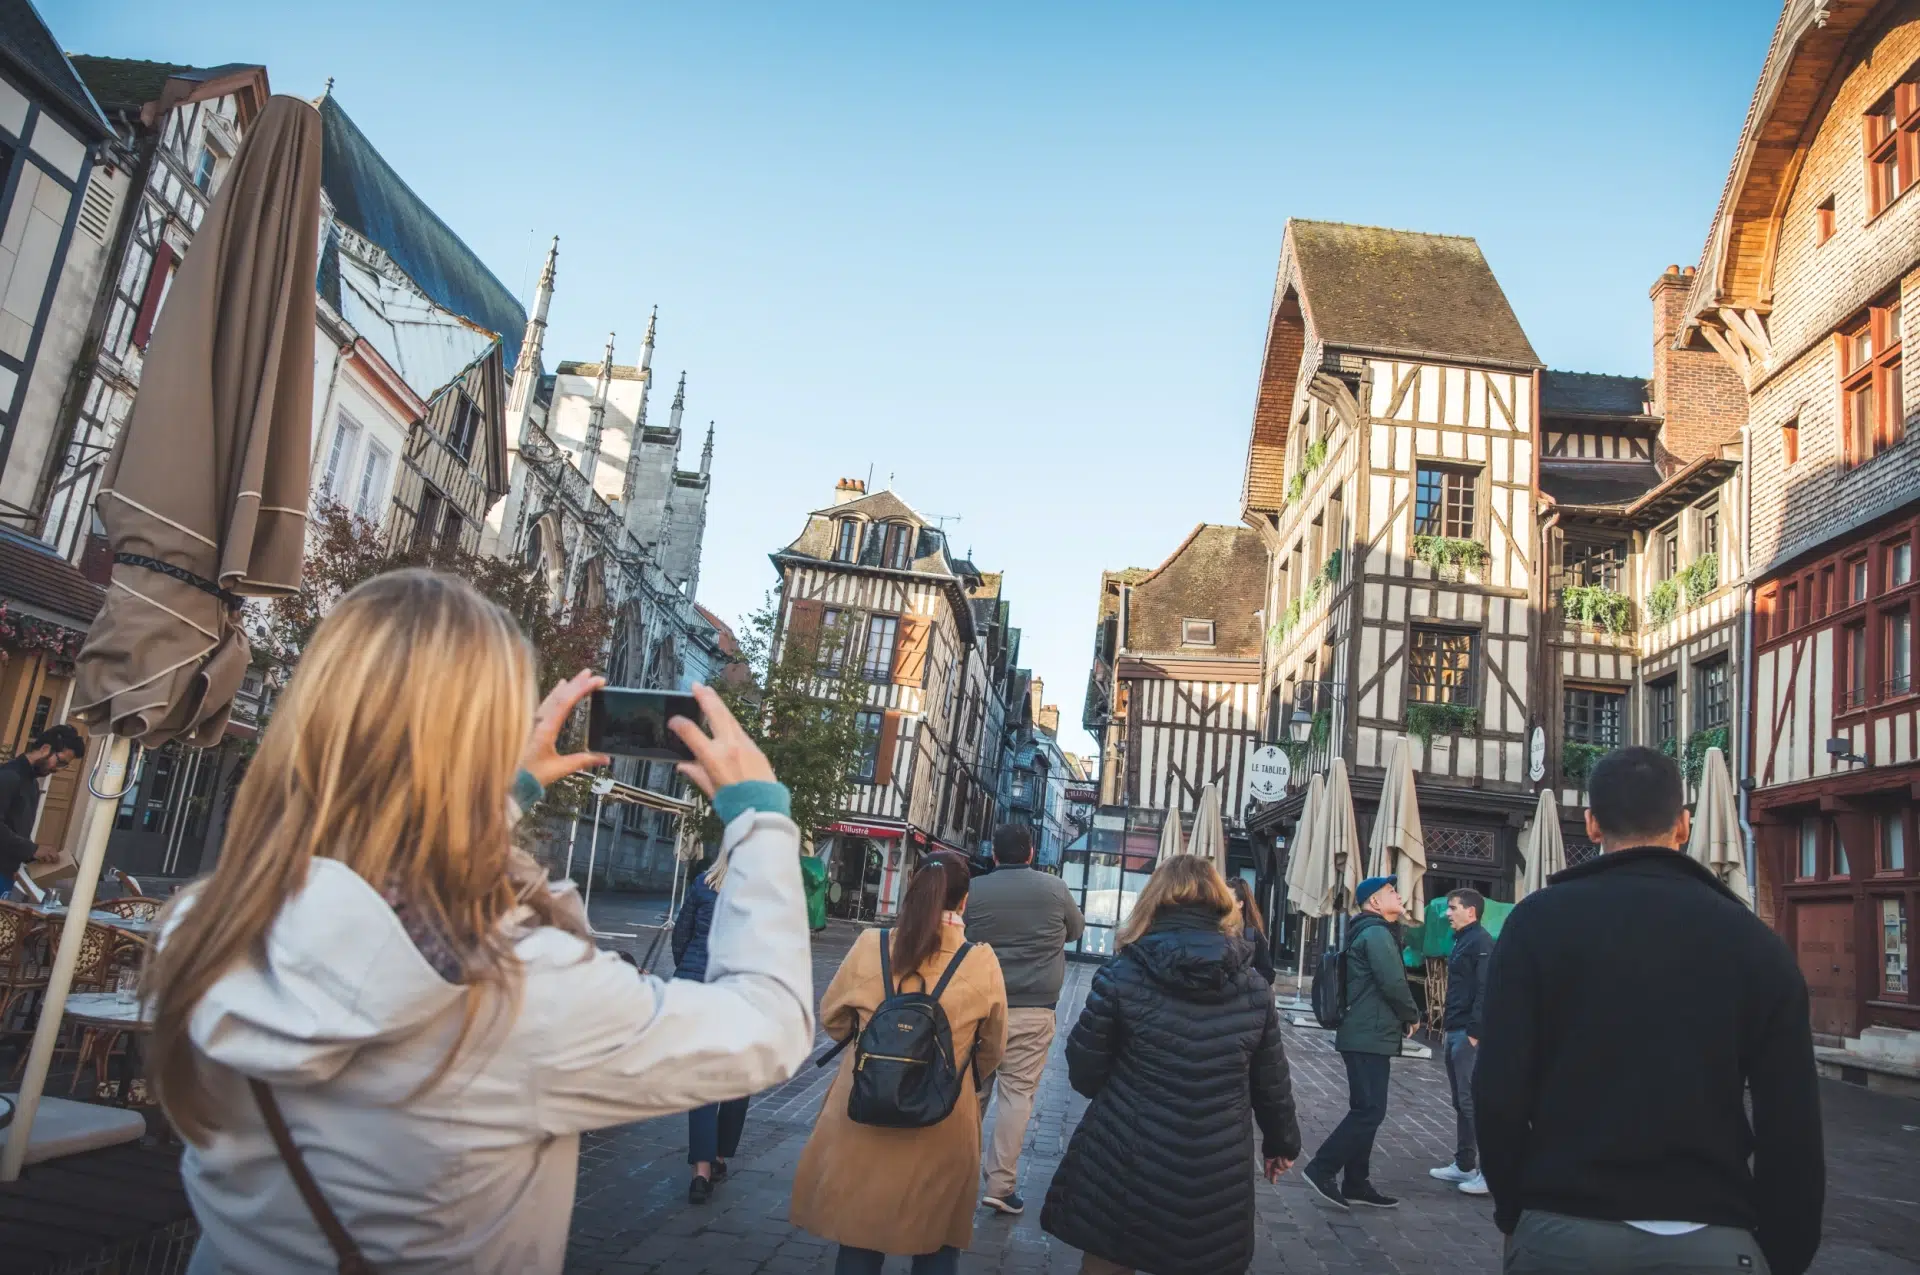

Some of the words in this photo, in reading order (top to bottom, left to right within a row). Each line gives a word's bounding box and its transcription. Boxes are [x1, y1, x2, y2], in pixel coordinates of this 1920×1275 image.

[1251, 763, 1260, 773] LE
[1261, 764, 1287, 776] TABLIER
[840, 824, 869, 835] L'Illustré
